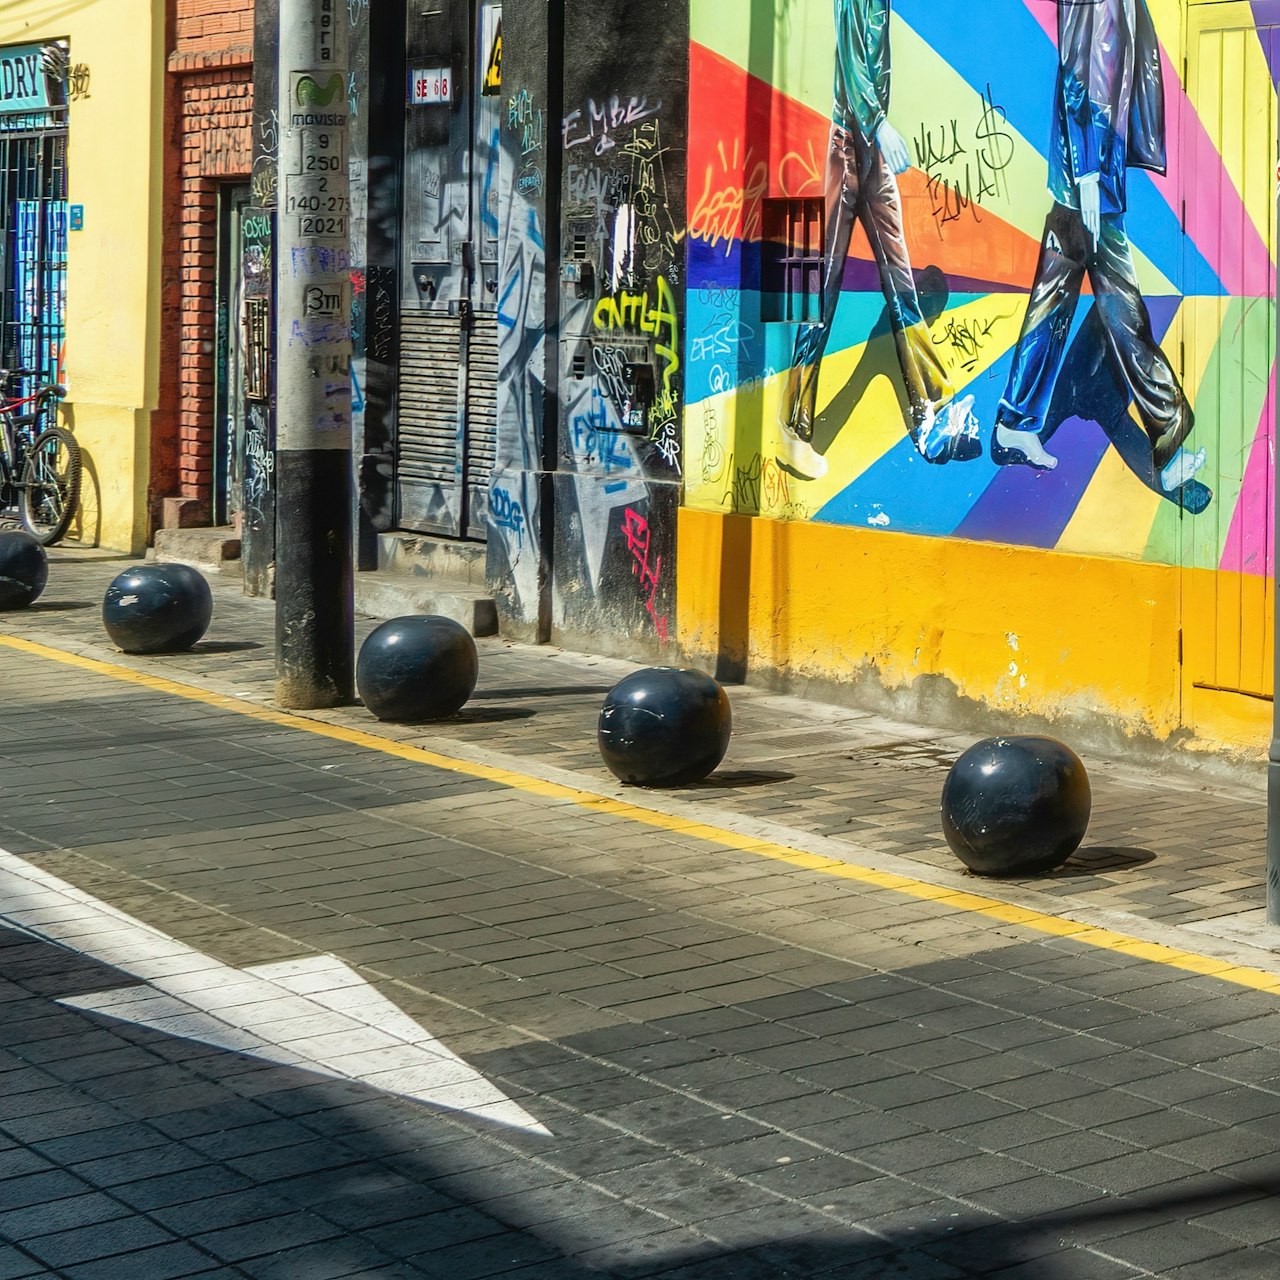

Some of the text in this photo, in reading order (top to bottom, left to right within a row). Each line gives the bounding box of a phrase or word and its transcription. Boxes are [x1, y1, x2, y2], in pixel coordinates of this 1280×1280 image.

[416, 79, 427, 97] SE
[292, 114, 348, 126] movistar
[318, 134, 329, 149] 9
[306, 156, 340, 170] 250
[318, 178, 328, 192] 2
[303, 218, 344, 233] 2021
